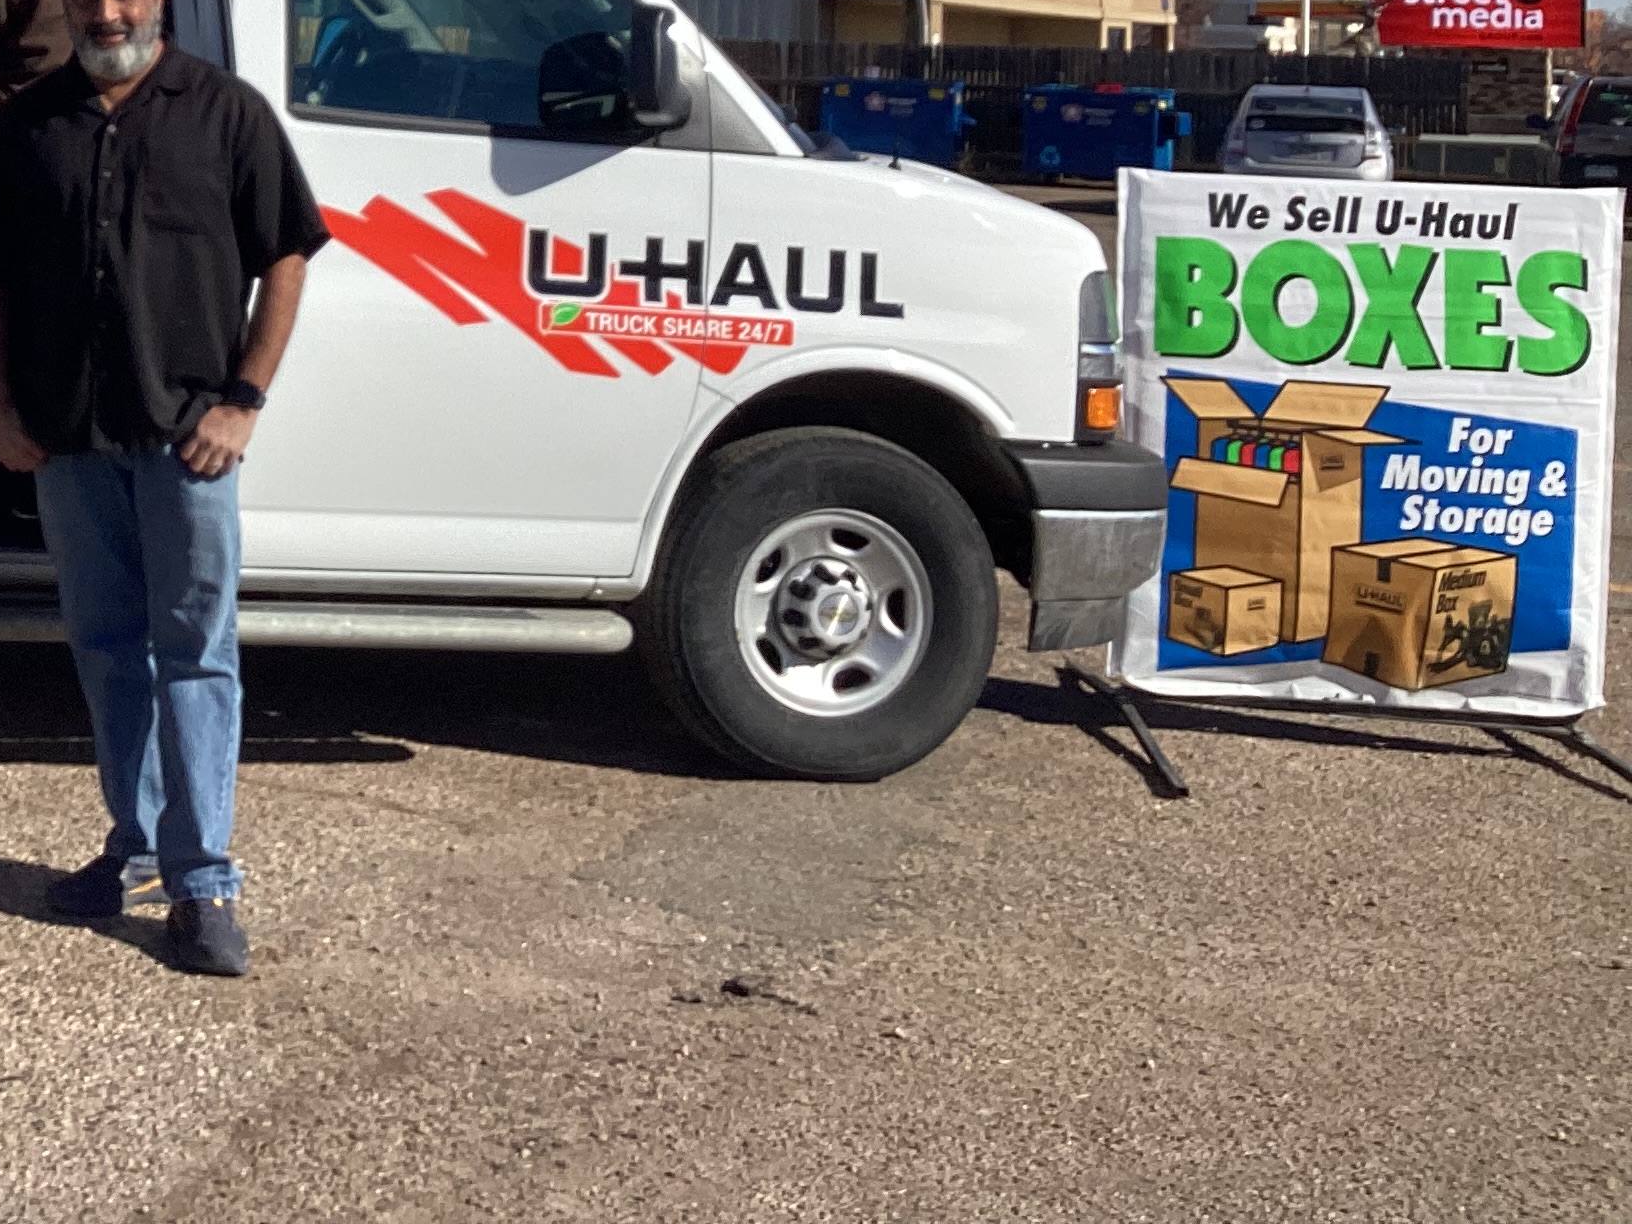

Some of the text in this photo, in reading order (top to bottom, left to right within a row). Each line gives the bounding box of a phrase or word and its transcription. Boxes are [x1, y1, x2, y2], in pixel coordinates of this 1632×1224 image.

[1208, 192, 1519, 241] We Sell U-Haul
[529, 228, 905, 319] U-HAUL
[586, 311, 786, 343] TRUCK SHARE 24/7
[1154, 236, 1592, 376] BOXES
[1447, 417, 1514, 455] For
[1380, 454, 1568, 507] Moving &
[1399, 494, 1556, 546] Storage
[1435, 594, 1459, 614] Box
[1438, 569, 1487, 592] Medium
